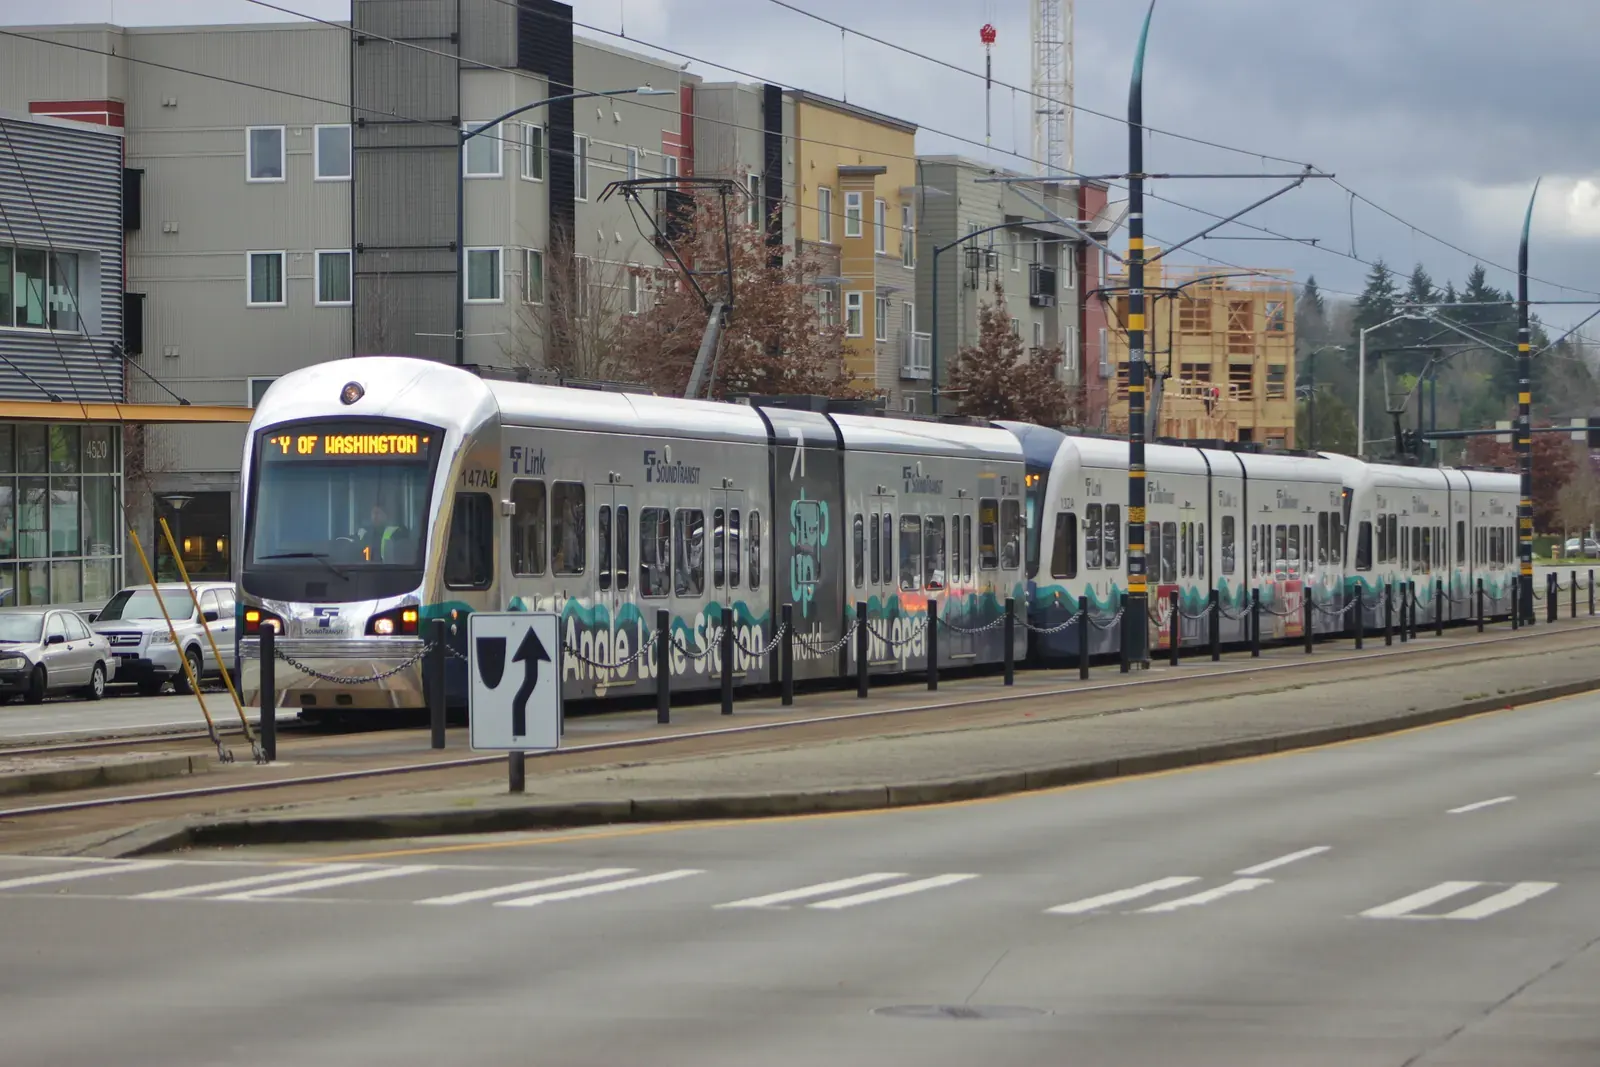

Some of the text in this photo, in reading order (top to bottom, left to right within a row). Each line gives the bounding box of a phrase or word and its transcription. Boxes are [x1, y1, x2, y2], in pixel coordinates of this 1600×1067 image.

[86, 440, 107, 459] 4520
[297, 436, 318, 454] OF
[325, 435, 417, 454] WASHINGTON
[524, 447, 546, 475] Link
[462, 468, 488, 488] 147A
[563, 609, 629, 697] Angle
[694, 608, 763, 674] Staion
[792, 621, 822, 661] world
